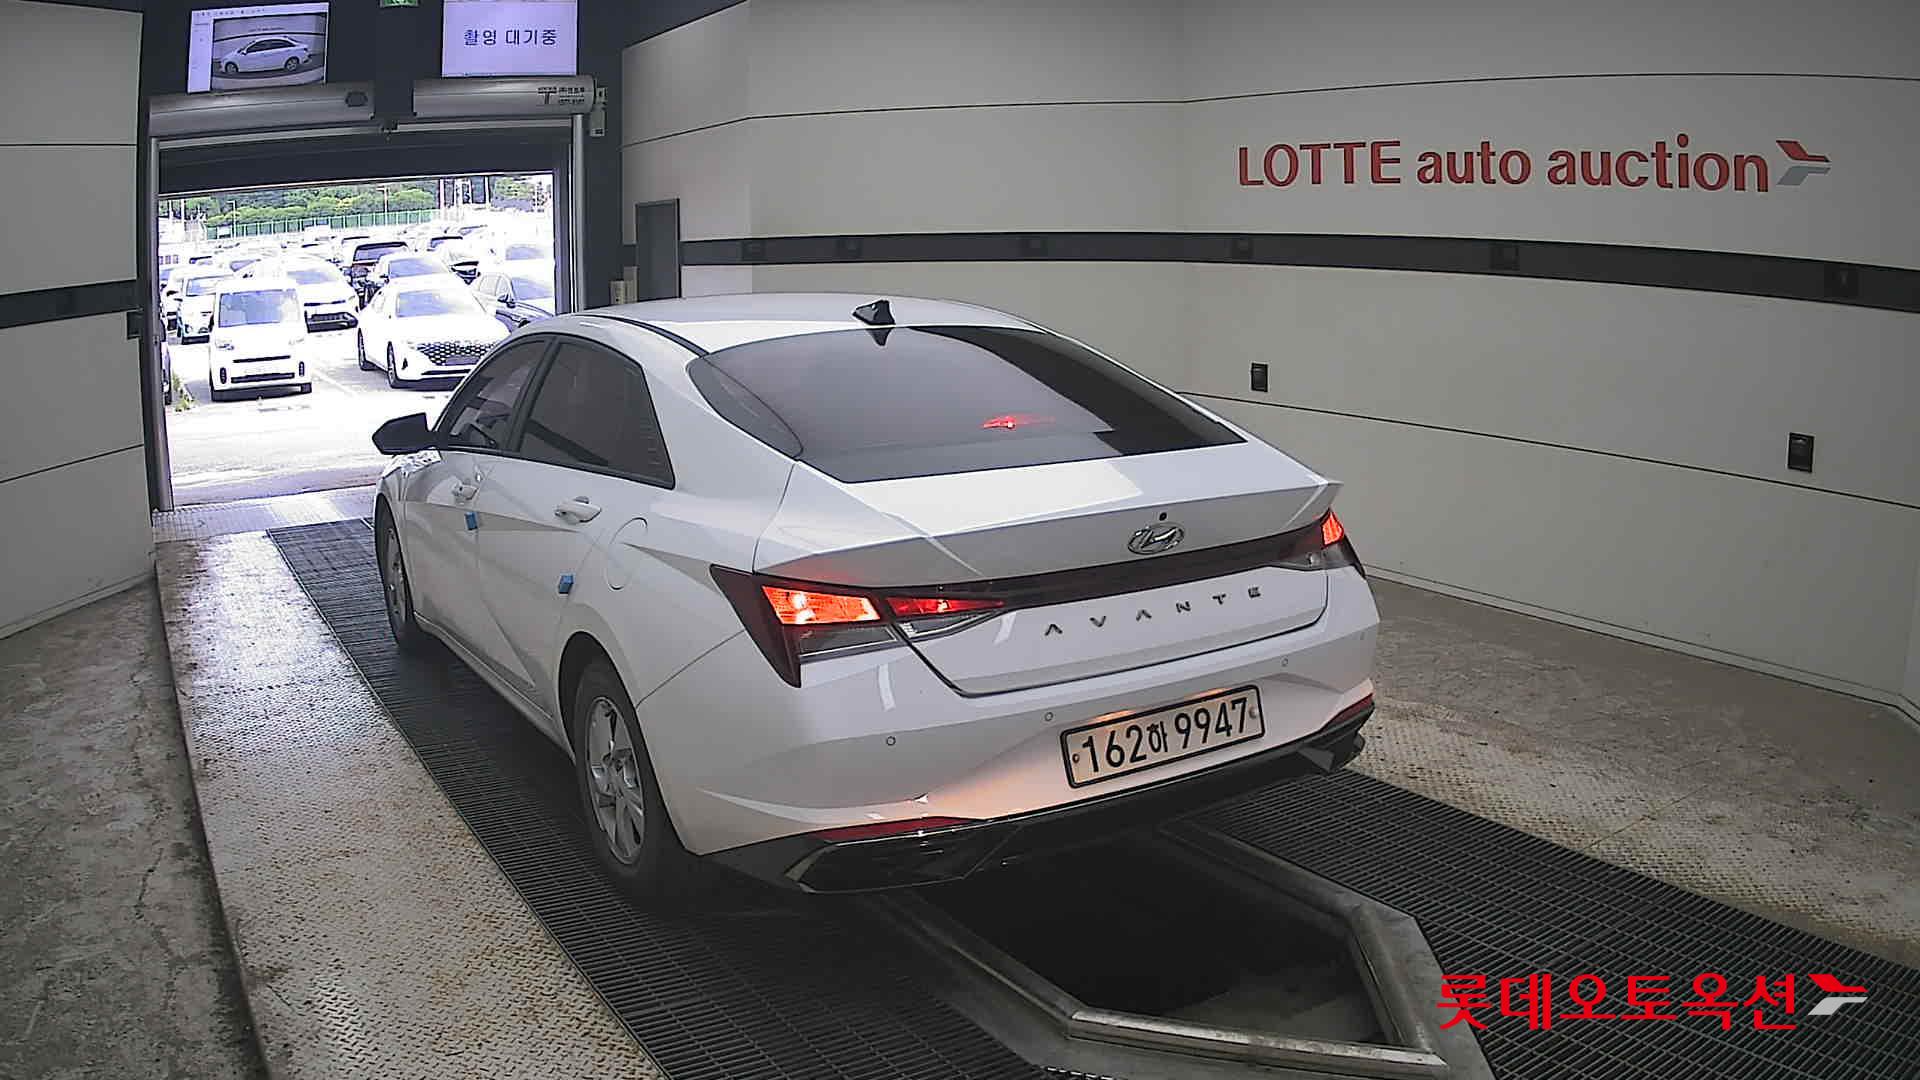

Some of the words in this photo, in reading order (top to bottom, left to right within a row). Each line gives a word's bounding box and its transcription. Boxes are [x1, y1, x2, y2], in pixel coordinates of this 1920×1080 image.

[505, 29, 557, 46] 대기중
[1239, 138, 1402, 188] LOTTE
[1415, 138, 1532, 185] auto
[1545, 131, 1770, 194] auction
[1044, 586, 1262, 637] AVANTE
